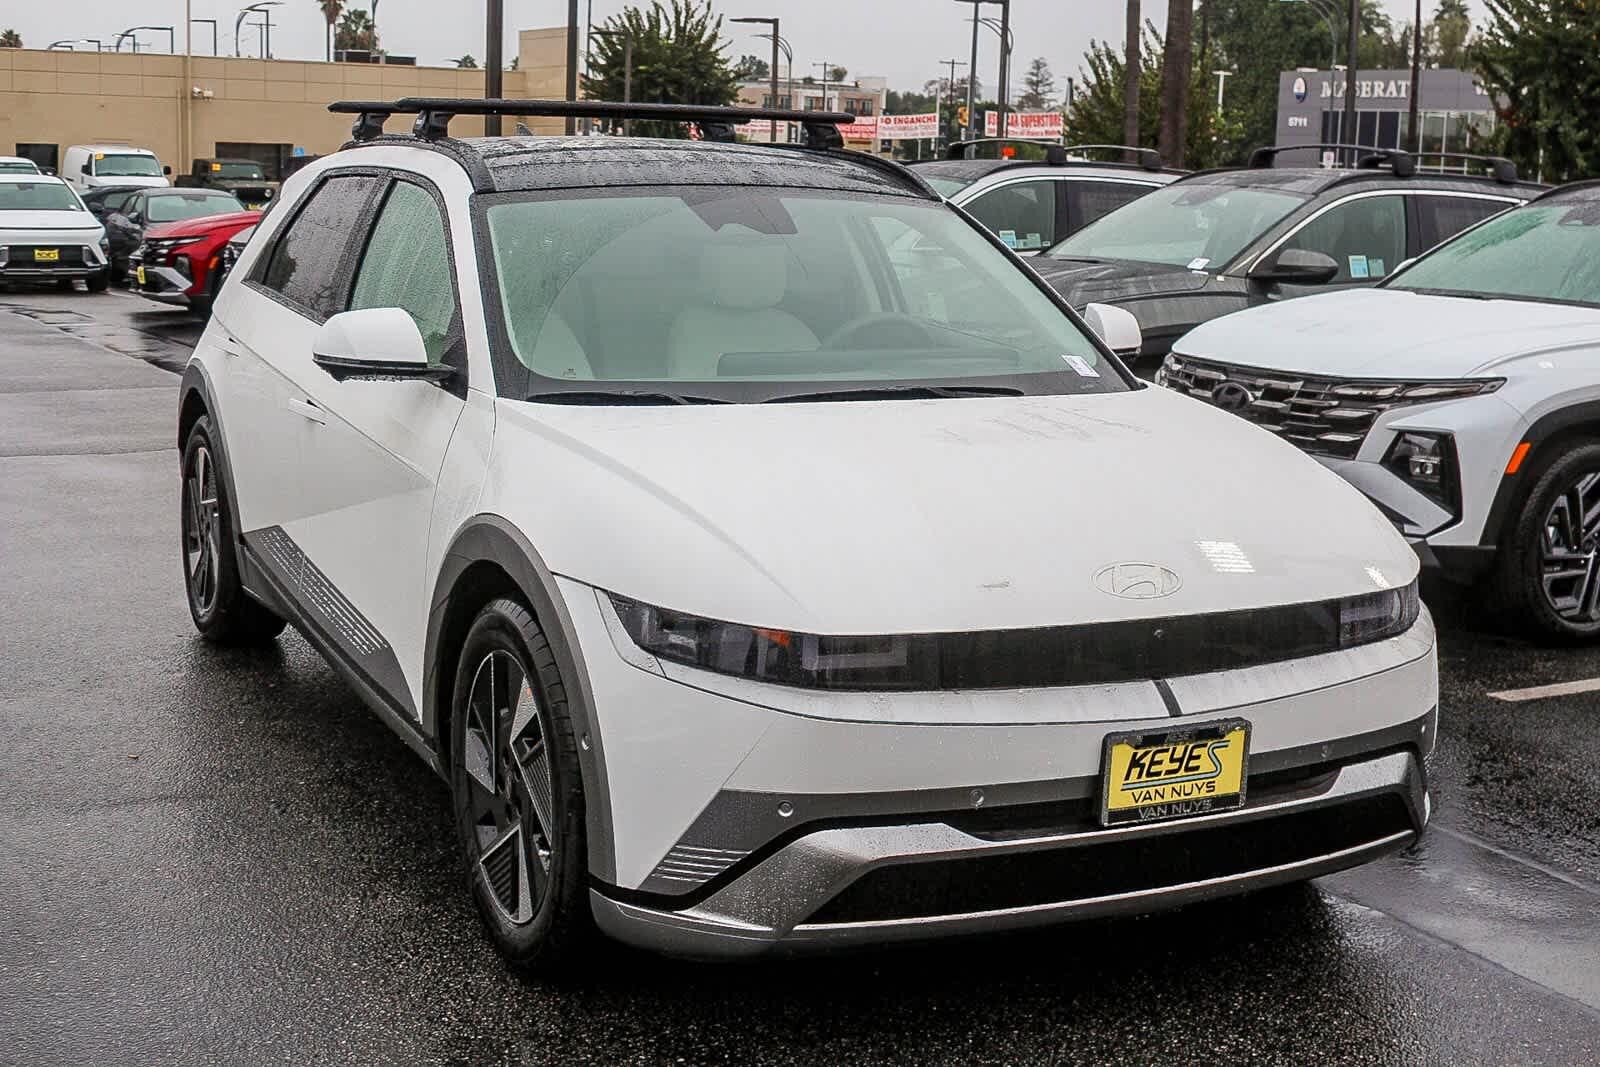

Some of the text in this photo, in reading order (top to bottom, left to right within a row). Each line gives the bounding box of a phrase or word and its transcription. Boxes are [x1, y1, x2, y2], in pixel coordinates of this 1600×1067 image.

[1320, 79, 1412, 98] MASERAT
[893, 115, 937, 125] ENGANCHE
[1122, 740, 1230, 784] KEYES
[1131, 780, 1216, 804] VAN NUYS
[1138, 799, 1213, 820] VAN NUYS
